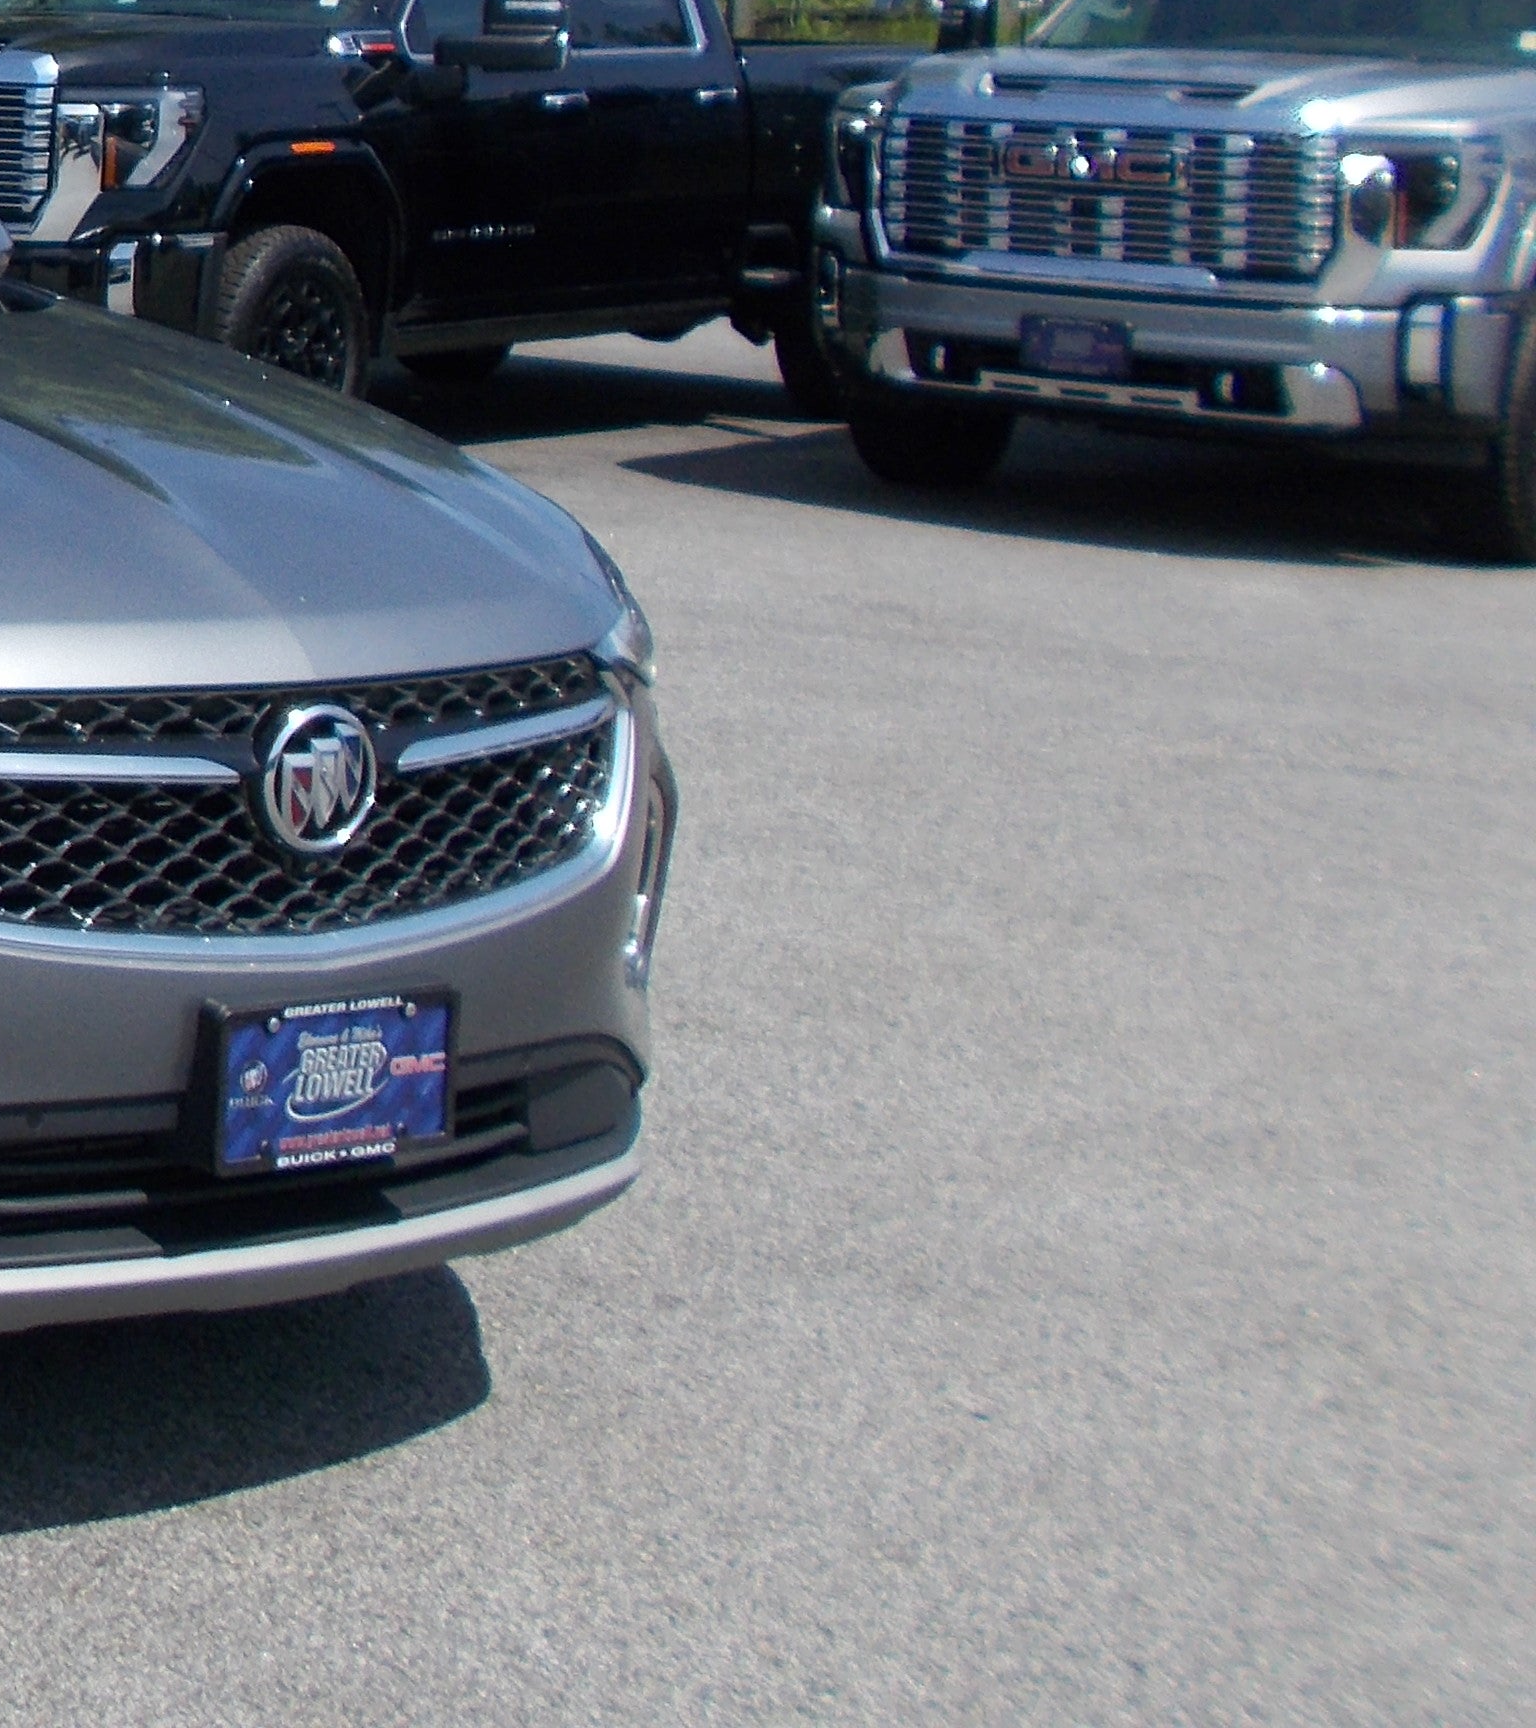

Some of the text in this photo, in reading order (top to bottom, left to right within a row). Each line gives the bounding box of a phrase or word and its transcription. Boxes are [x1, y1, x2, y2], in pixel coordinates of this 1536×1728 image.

[283, 995, 404, 1019] GREATER LOWELL
[299, 1041, 386, 1074] GREATER
[294, 1067, 375, 1103] LOWELL
[276, 1148, 337, 1169] BUICK
